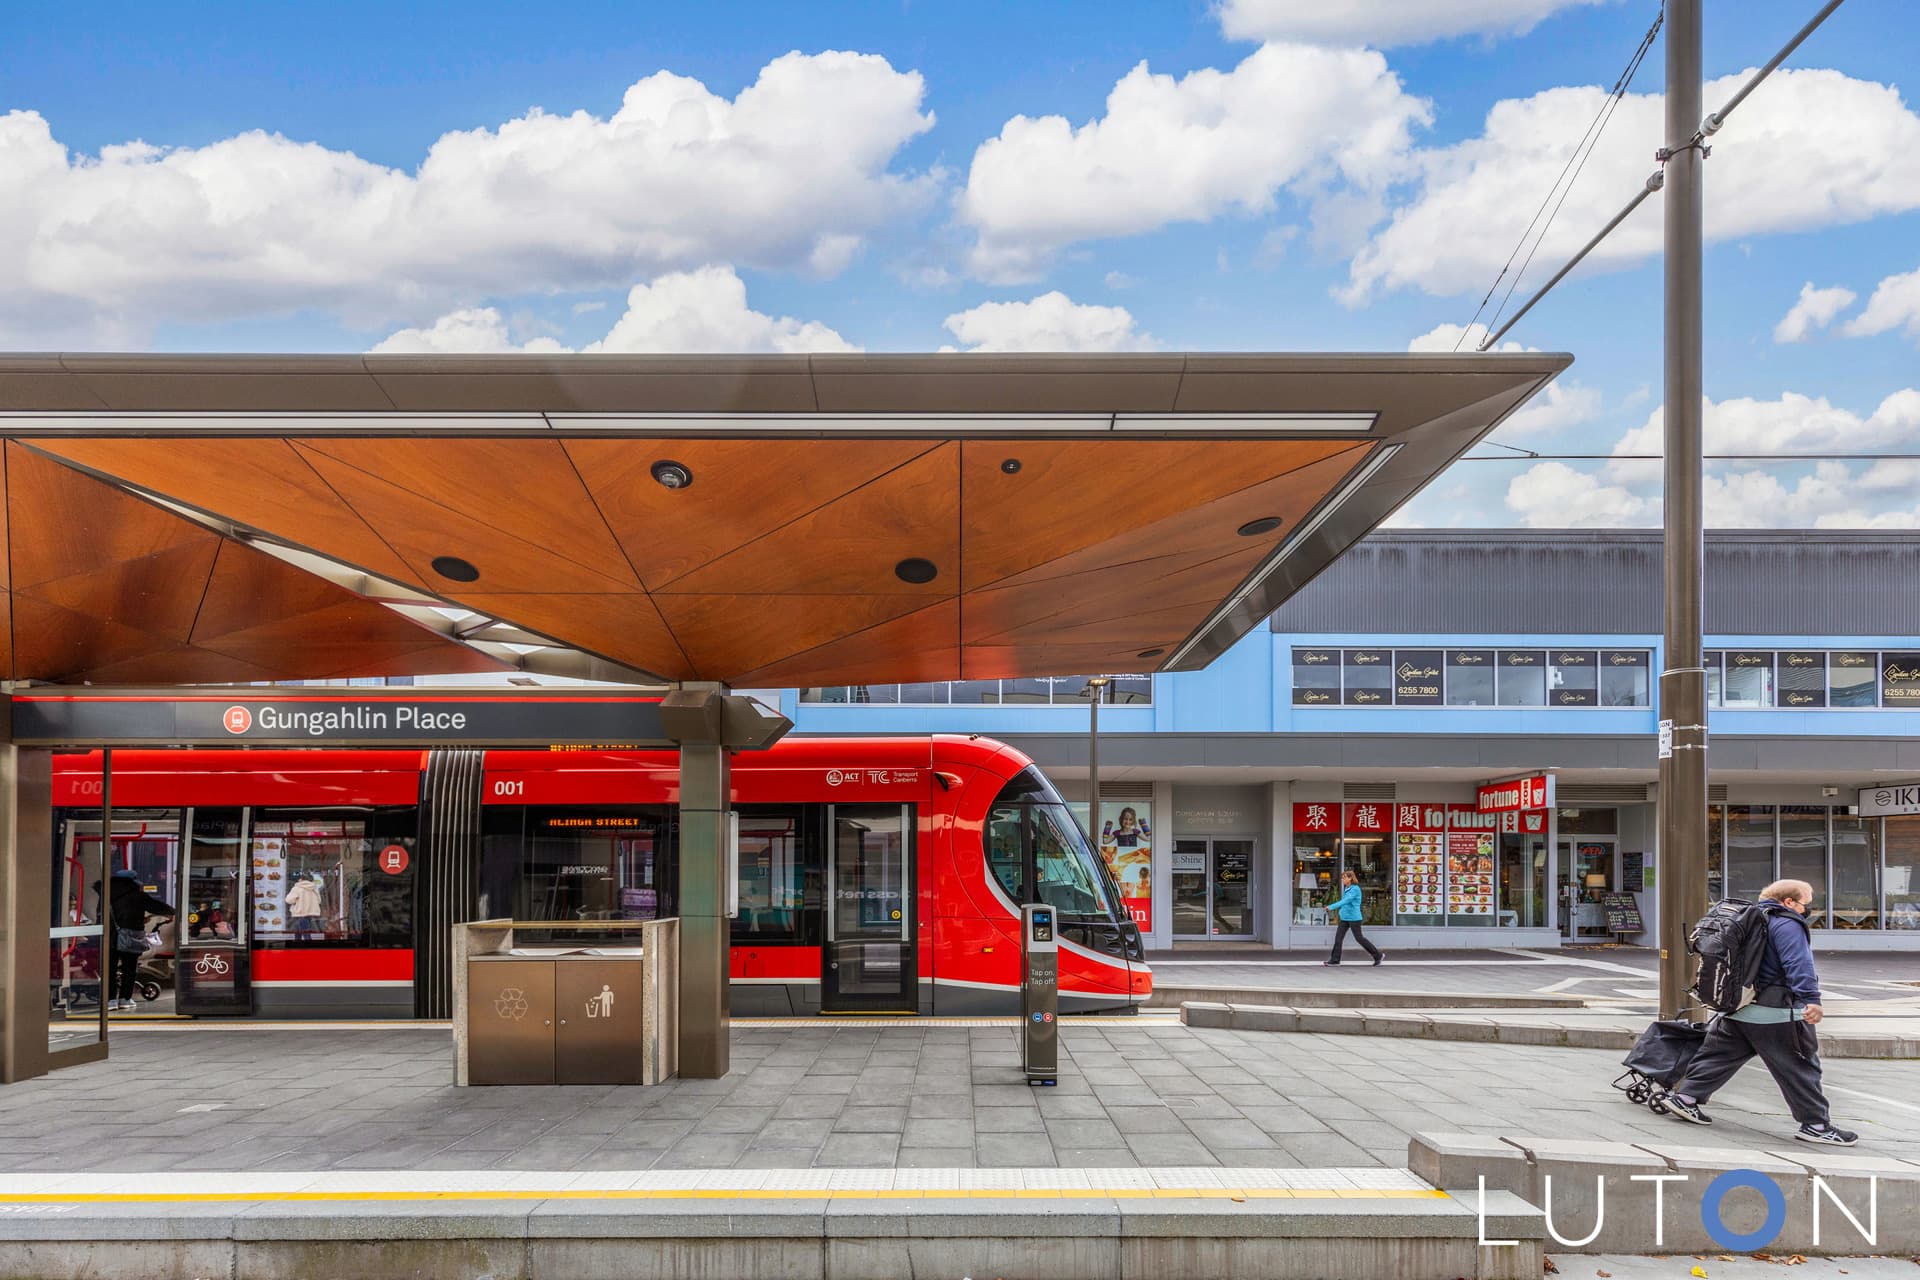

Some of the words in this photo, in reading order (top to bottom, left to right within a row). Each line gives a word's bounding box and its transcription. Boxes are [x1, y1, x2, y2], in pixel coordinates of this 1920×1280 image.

[1884, 688, 1904, 696] 6255
[1905, 688, 1920, 696] 780
[258, 706, 387, 735] Gungahlin
[395, 706, 466, 730] Place
[867, 770, 890, 784] TC
[494, 780, 524, 796] 001
[1480, 789, 1519, 810] fortune
[1895, 787, 1920, 806] IK
[549, 818, 592, 826] ALINGA
[596, 818, 639, 826] STREET
[1306, 804, 1420, 831] 聚龍閣
[1424, 808, 1496, 828] fortune
[1506, 813, 1515, 831] OX
[1180, 855, 1203, 864] Shine
[1031, 969, 1043, 977] Tap
